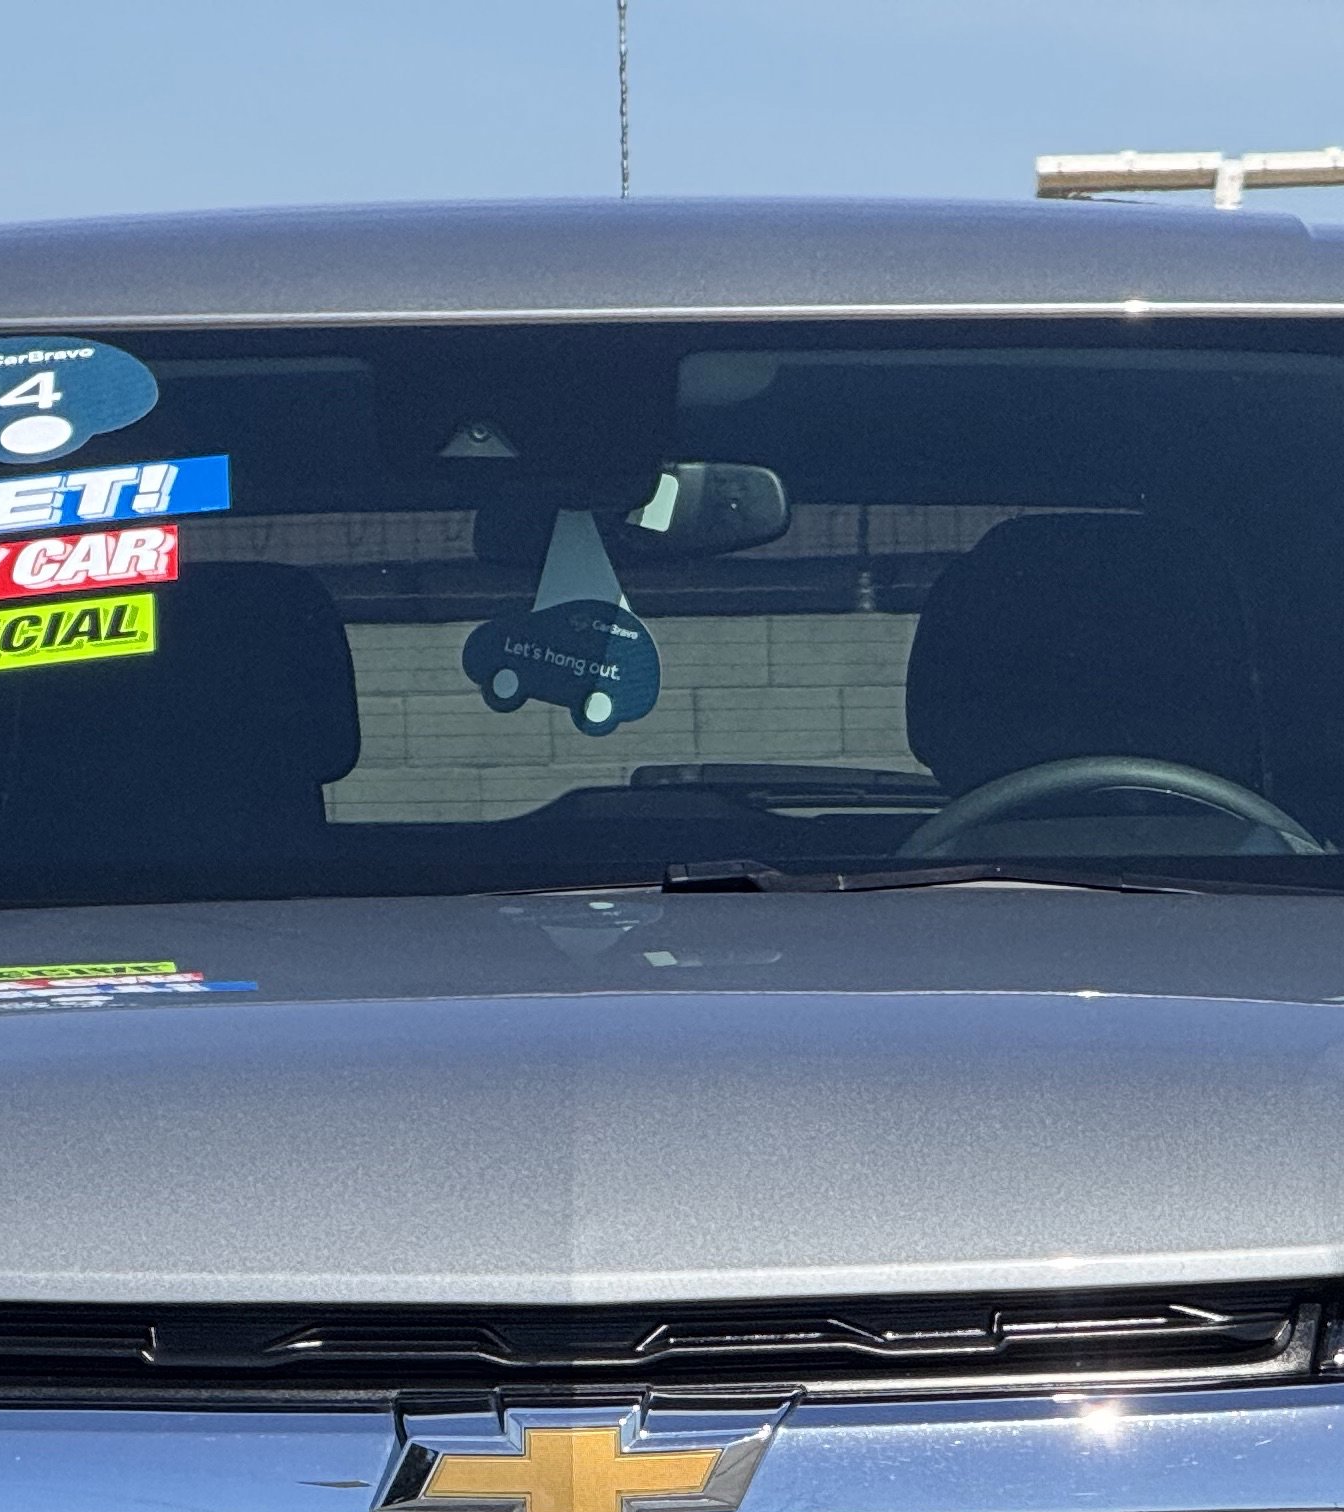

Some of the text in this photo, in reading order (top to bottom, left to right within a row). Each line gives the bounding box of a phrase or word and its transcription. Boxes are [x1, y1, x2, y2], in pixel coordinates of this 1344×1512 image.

[11, 528, 176, 588] CAR
[504, 638, 621, 681] Let's hang out.
